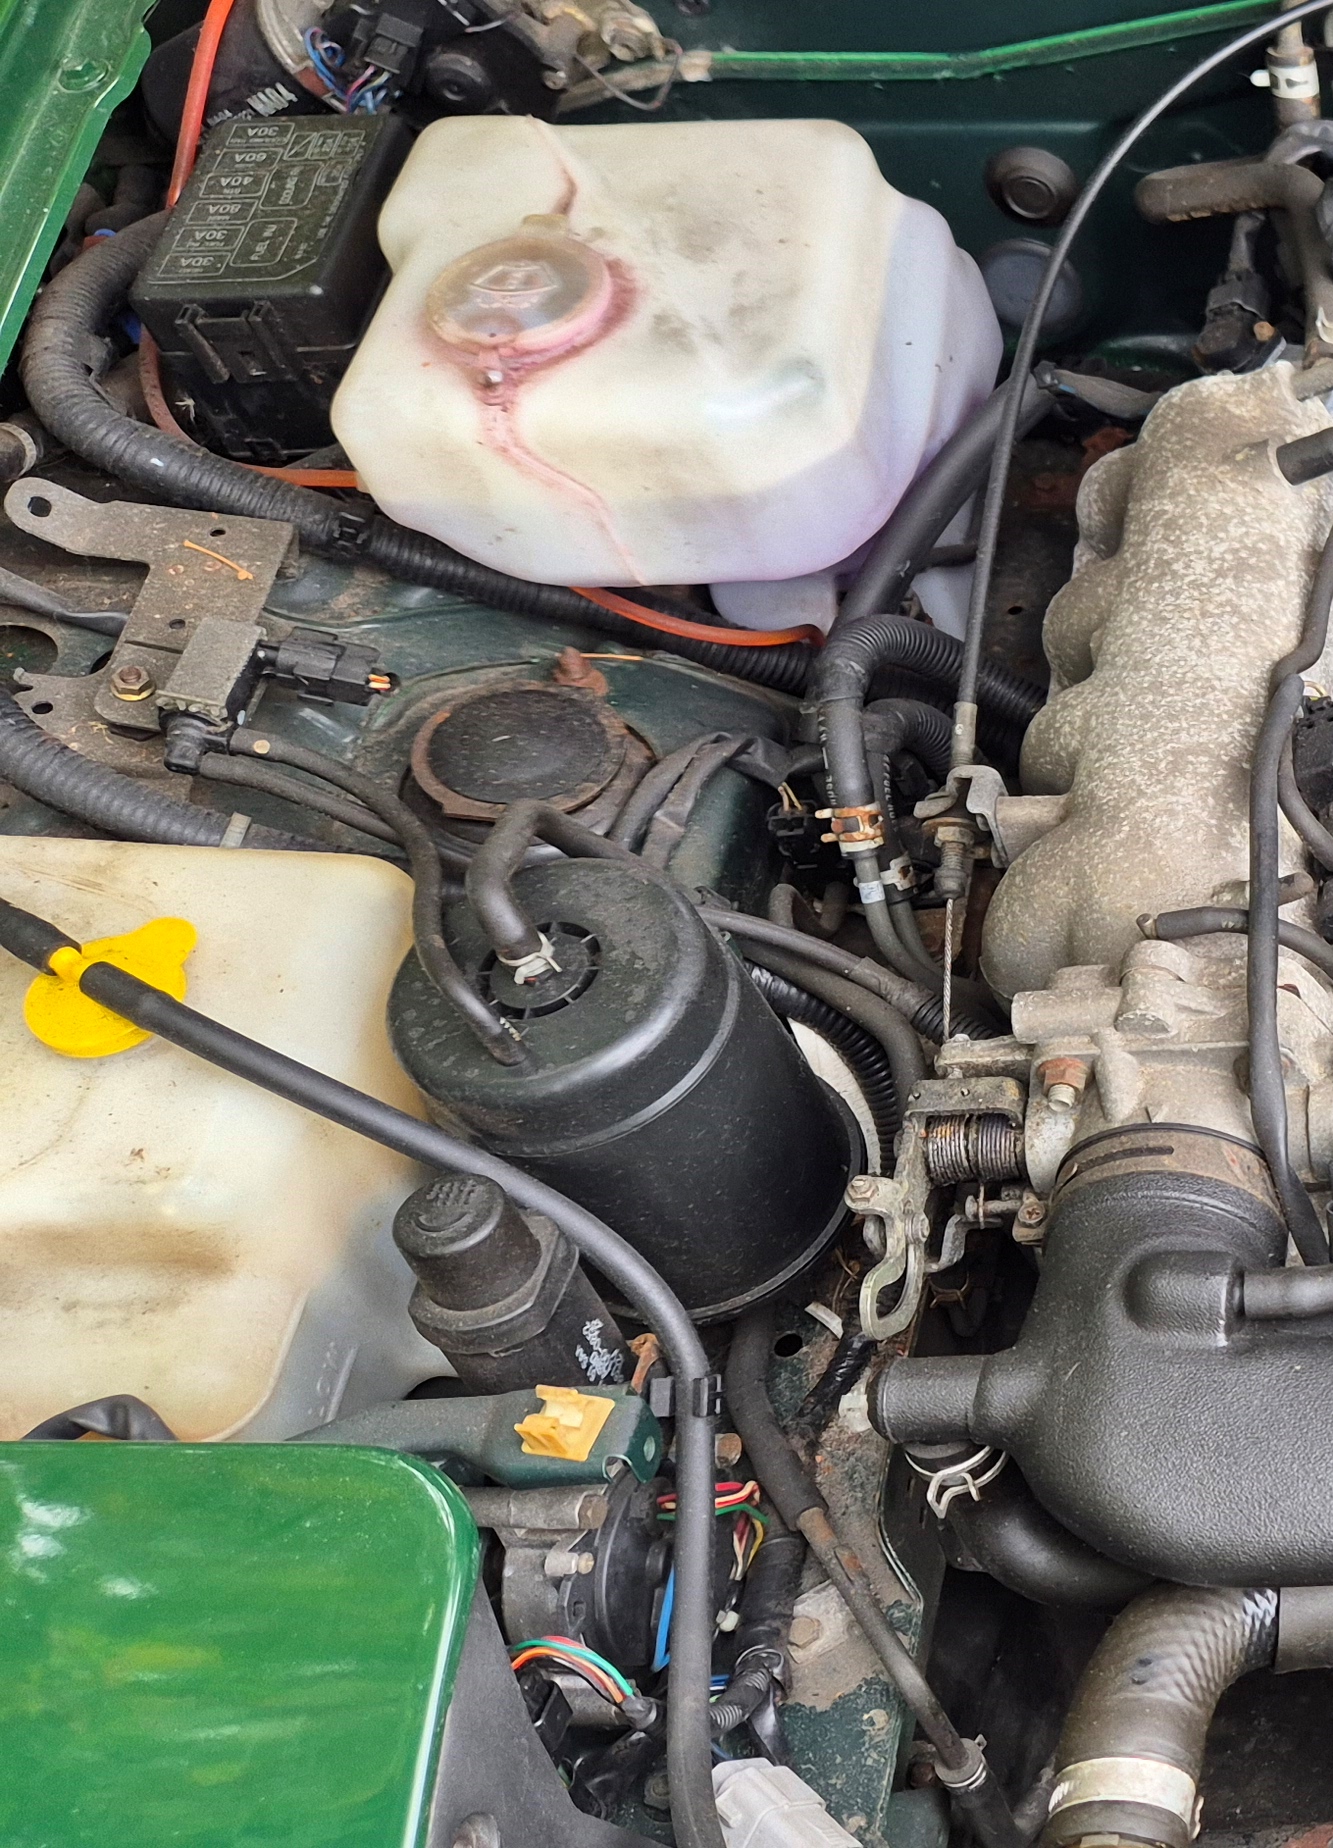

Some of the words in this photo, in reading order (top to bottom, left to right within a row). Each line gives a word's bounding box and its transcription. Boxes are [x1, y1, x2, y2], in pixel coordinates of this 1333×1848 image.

[247, 126, 280, 137] 30A
[234, 152, 268, 163] 60A
[220, 176, 254, 186] 40A
[208, 203, 242, 214] 80A
[195, 230, 229, 241] 30A
[181, 256, 214, 267] 30A
